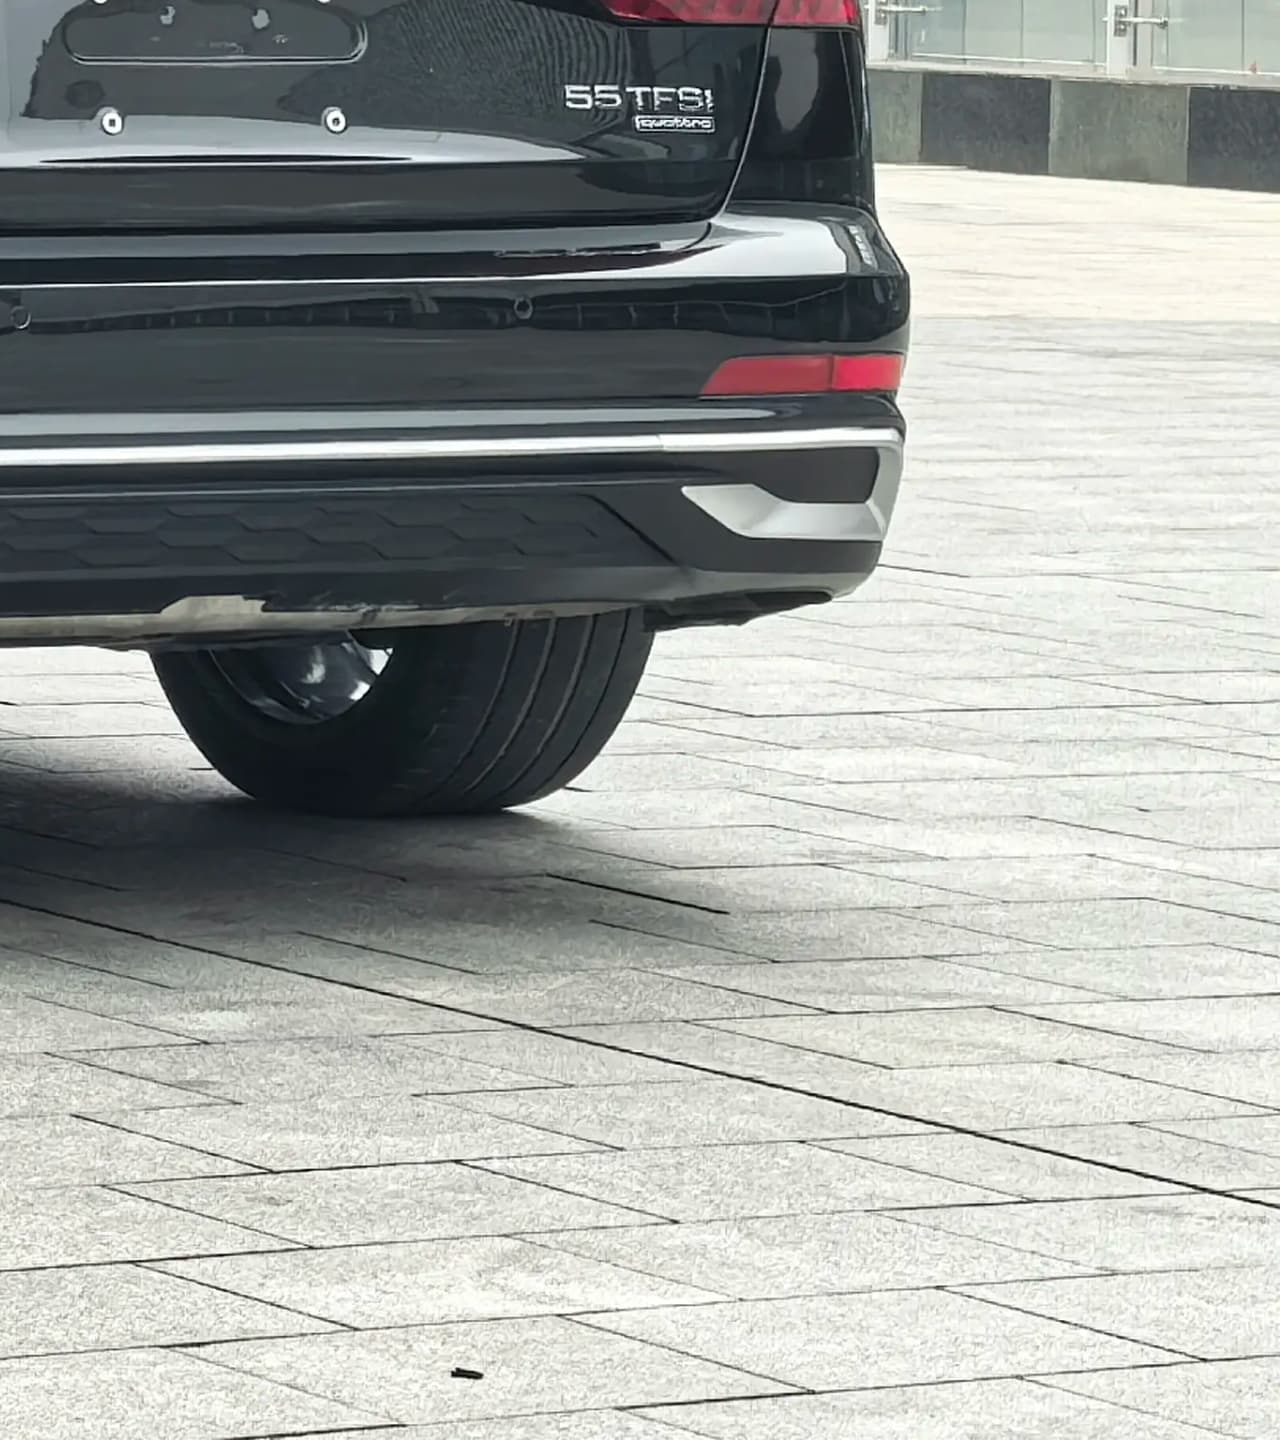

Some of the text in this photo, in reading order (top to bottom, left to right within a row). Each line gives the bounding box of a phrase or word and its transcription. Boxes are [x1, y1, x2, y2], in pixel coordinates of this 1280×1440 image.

[564, 84, 714, 112] 55 TFSI
[638, 117, 713, 130] quattro
